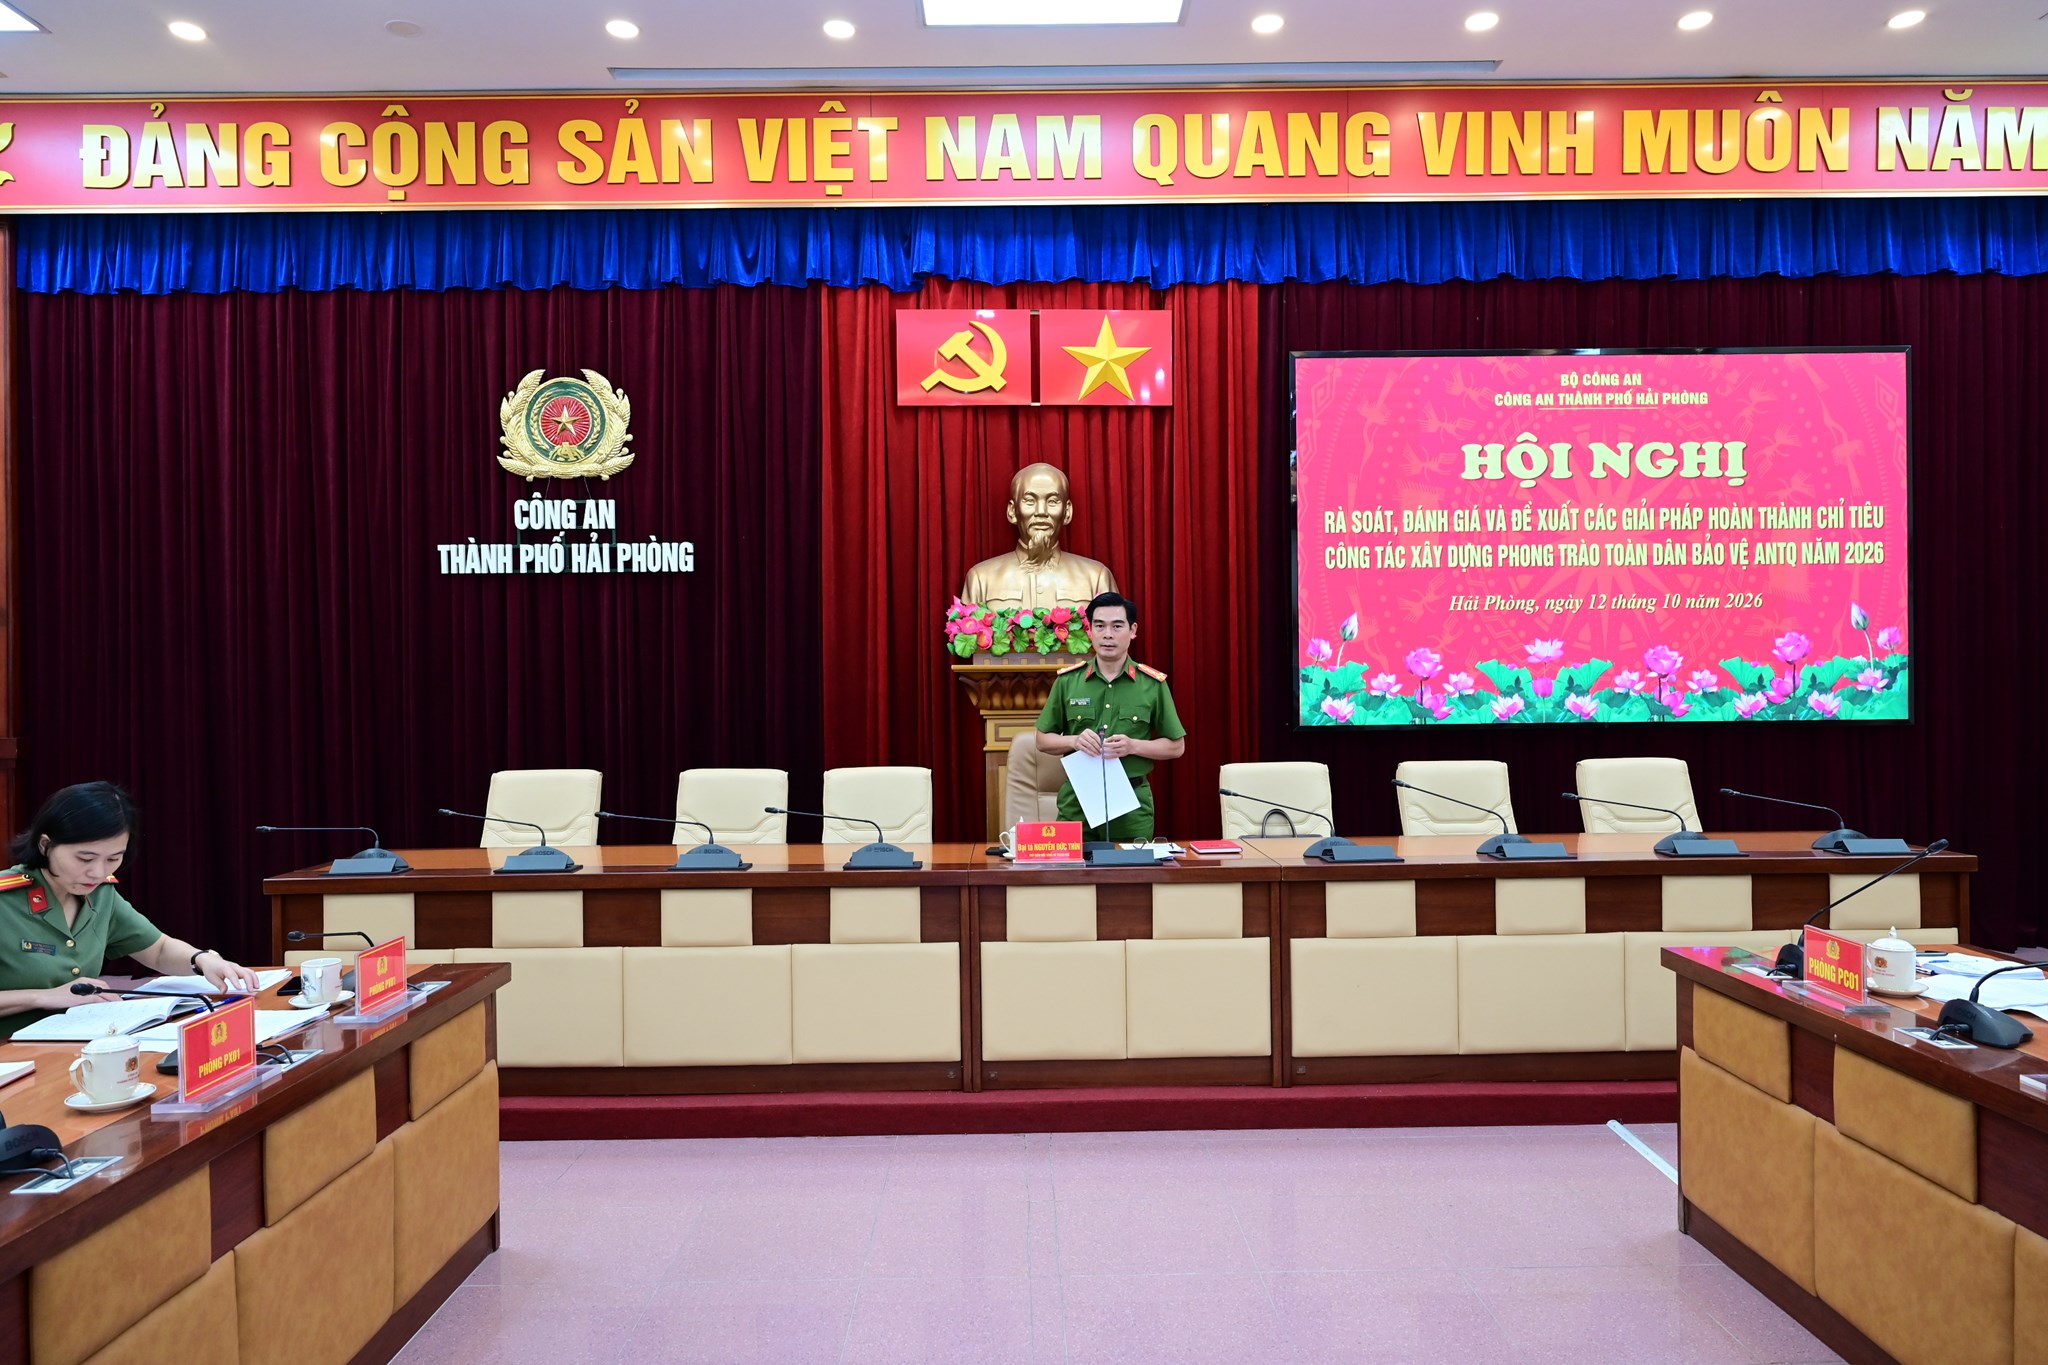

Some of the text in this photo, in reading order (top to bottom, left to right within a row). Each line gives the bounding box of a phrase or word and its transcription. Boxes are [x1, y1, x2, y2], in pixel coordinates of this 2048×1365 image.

[80, 89, 2048, 201] ĐẢNG CỘNG SẢN VIỆT NAM QUANG VINH MUÔN NĂM
[1494, 388, 1708, 406] CÔNG AN THÀNH PHỐ HẢI PHÒNG
[1560, 372, 1642, 388] BỘ CÔNG AN
[1461, 432, 1748, 488] HỘI NGHỊ
[514, 492, 616, 530] CÔNG AN
[1324, 498, 1884, 536] RÀ SOÁT, ĐÁNH GIÁ VÀ ĐỀ XUẤT CÁC GIẢI PHÁP HOÀN THÀNH CHỈ TIÊU
[437, 531, 694, 574] THÀNH PHỐ HẢI PHÒNG
[1324, 533, 1884, 572] CÔNG TÁC XÂY DỰNG PHONG TRÀO TOÀN DÂN BẢO VỆ ANTQ NĂM 2026
[1449, 592, 1764, 615] Hải Phòng, ngày 12 tháng 10 năm 2026
[369, 981, 385, 997] PHÒNG
[1809, 957, 1859, 992] PHÒNG PC01
[199, 1048, 240, 1078] PHÒNG PX01
